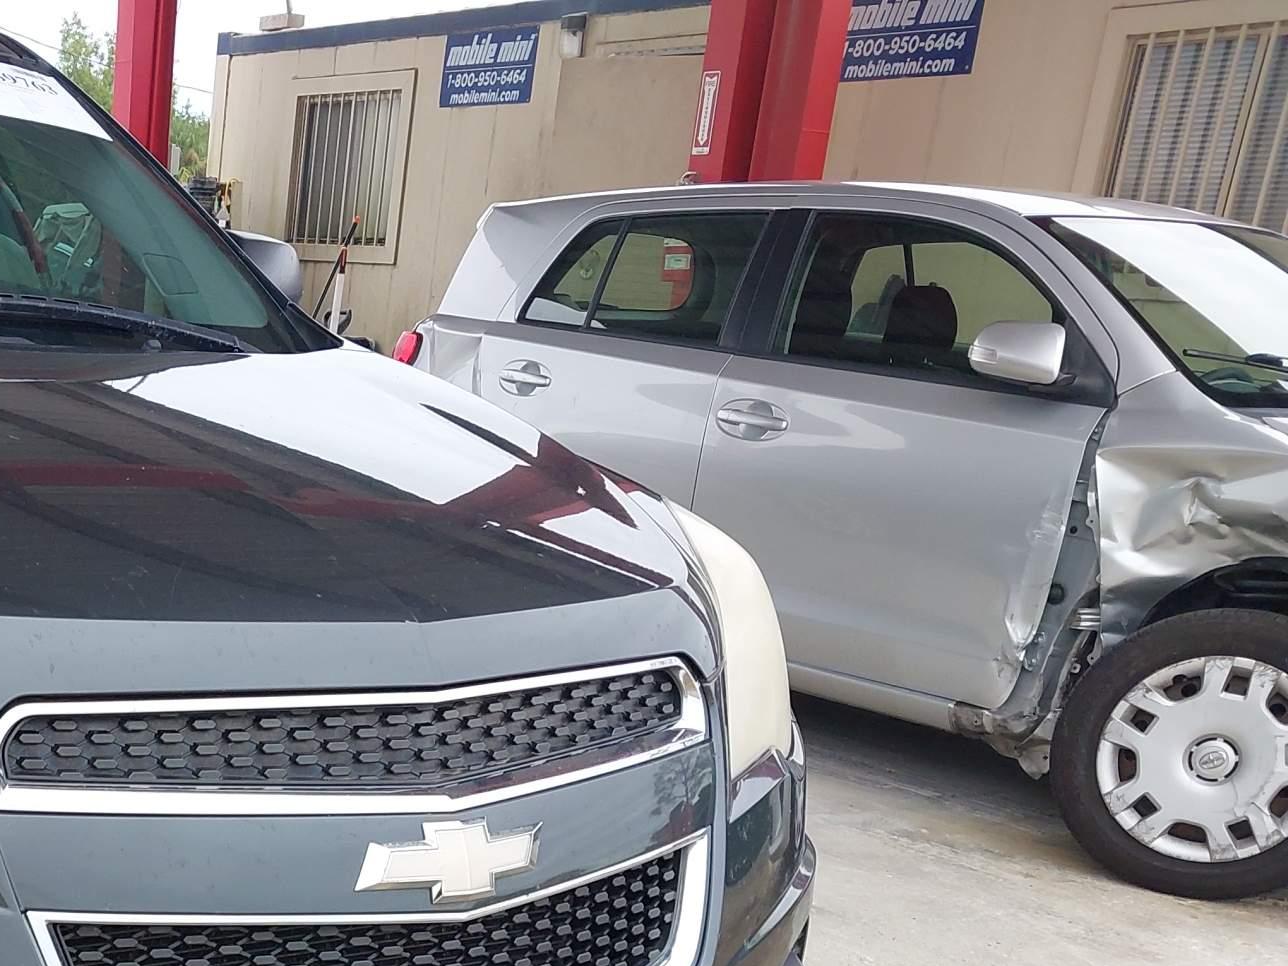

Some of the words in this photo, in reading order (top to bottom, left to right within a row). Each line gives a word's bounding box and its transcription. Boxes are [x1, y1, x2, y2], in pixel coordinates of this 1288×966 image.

[919, 0, 977, 25] mini
[446, 33, 498, 67] mobile
[496, 33, 536, 62] mini
[842, 31, 967, 59] 1-800-950-6464
[447, 69, 527, 89] 1-800-950-6464
[844, 57, 955, 79] mobilemini.com
[449, 88, 520, 105] mobilemini.com
